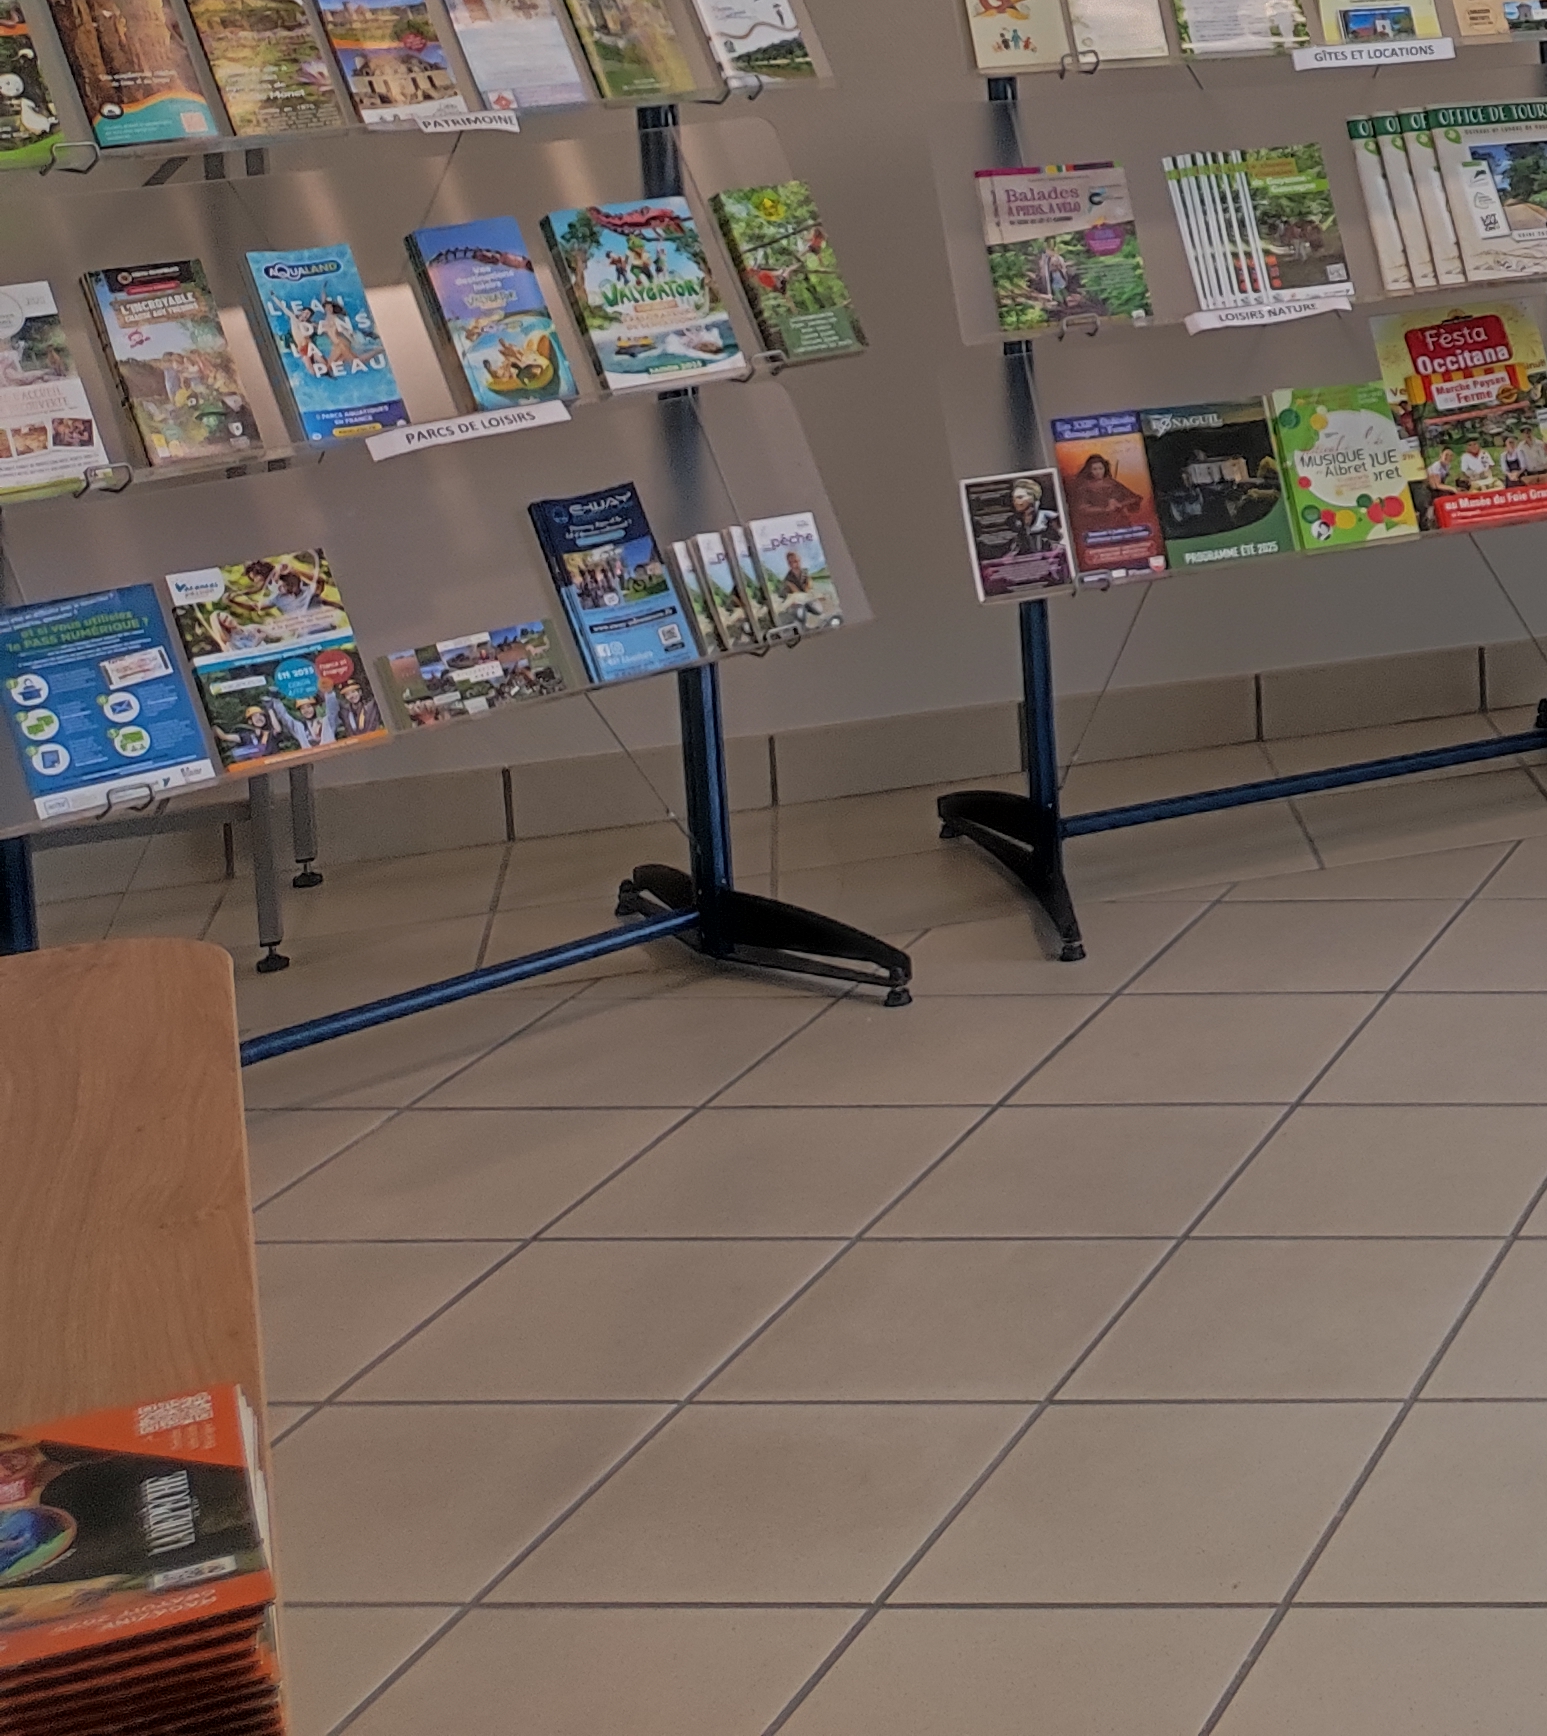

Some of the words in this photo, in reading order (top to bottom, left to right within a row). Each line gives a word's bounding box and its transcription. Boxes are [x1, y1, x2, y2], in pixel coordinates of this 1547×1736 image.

[1314, 47, 1348, 62] GÎTES
[1351, 49, 1366, 61] ET
[1369, 45, 1435, 60] LOCATIONS
[422, 113, 515, 130] PATRIMOINE
[1439, 107, 1486, 125] OFFICE
[1490, 105, 1508, 122] DE
[1005, 186, 1080, 203] Balades
[268, 262, 339, 280] AQUALAND
[121, 292, 196, 314] L'INCROYABLE
[1218, 307, 1265, 322] LOISIRS
[1268, 303, 1318, 318] NATURE
[300, 312, 372, 337] DANS
[1425, 325, 1488, 352] Fèsta
[314, 354, 387, 378] PEAU
[1417, 344, 1510, 375] Occitana
[1473, 374, 1508, 391] Paysan
[1456, 389, 1493, 404] Ferme
[405, 424, 455, 445] PARCS
[459, 420, 480, 434] DE
[482, 411, 536, 430] LOISIRS
[1300, 448, 1366, 468] MUSIQUE
[1325, 461, 1368, 478] Albret
[1460, 496, 1492, 509] Musée
[1508, 492, 1528, 504] Foie
[771, 531, 814, 550] pêche
[1184, 546, 1239, 564] PROGRAMME
[1240, 542, 1257, 557] ÉTÉ
[1257, 540, 1279, 555] 2025
[62, 619, 140, 644] NUMÉRIQUE
